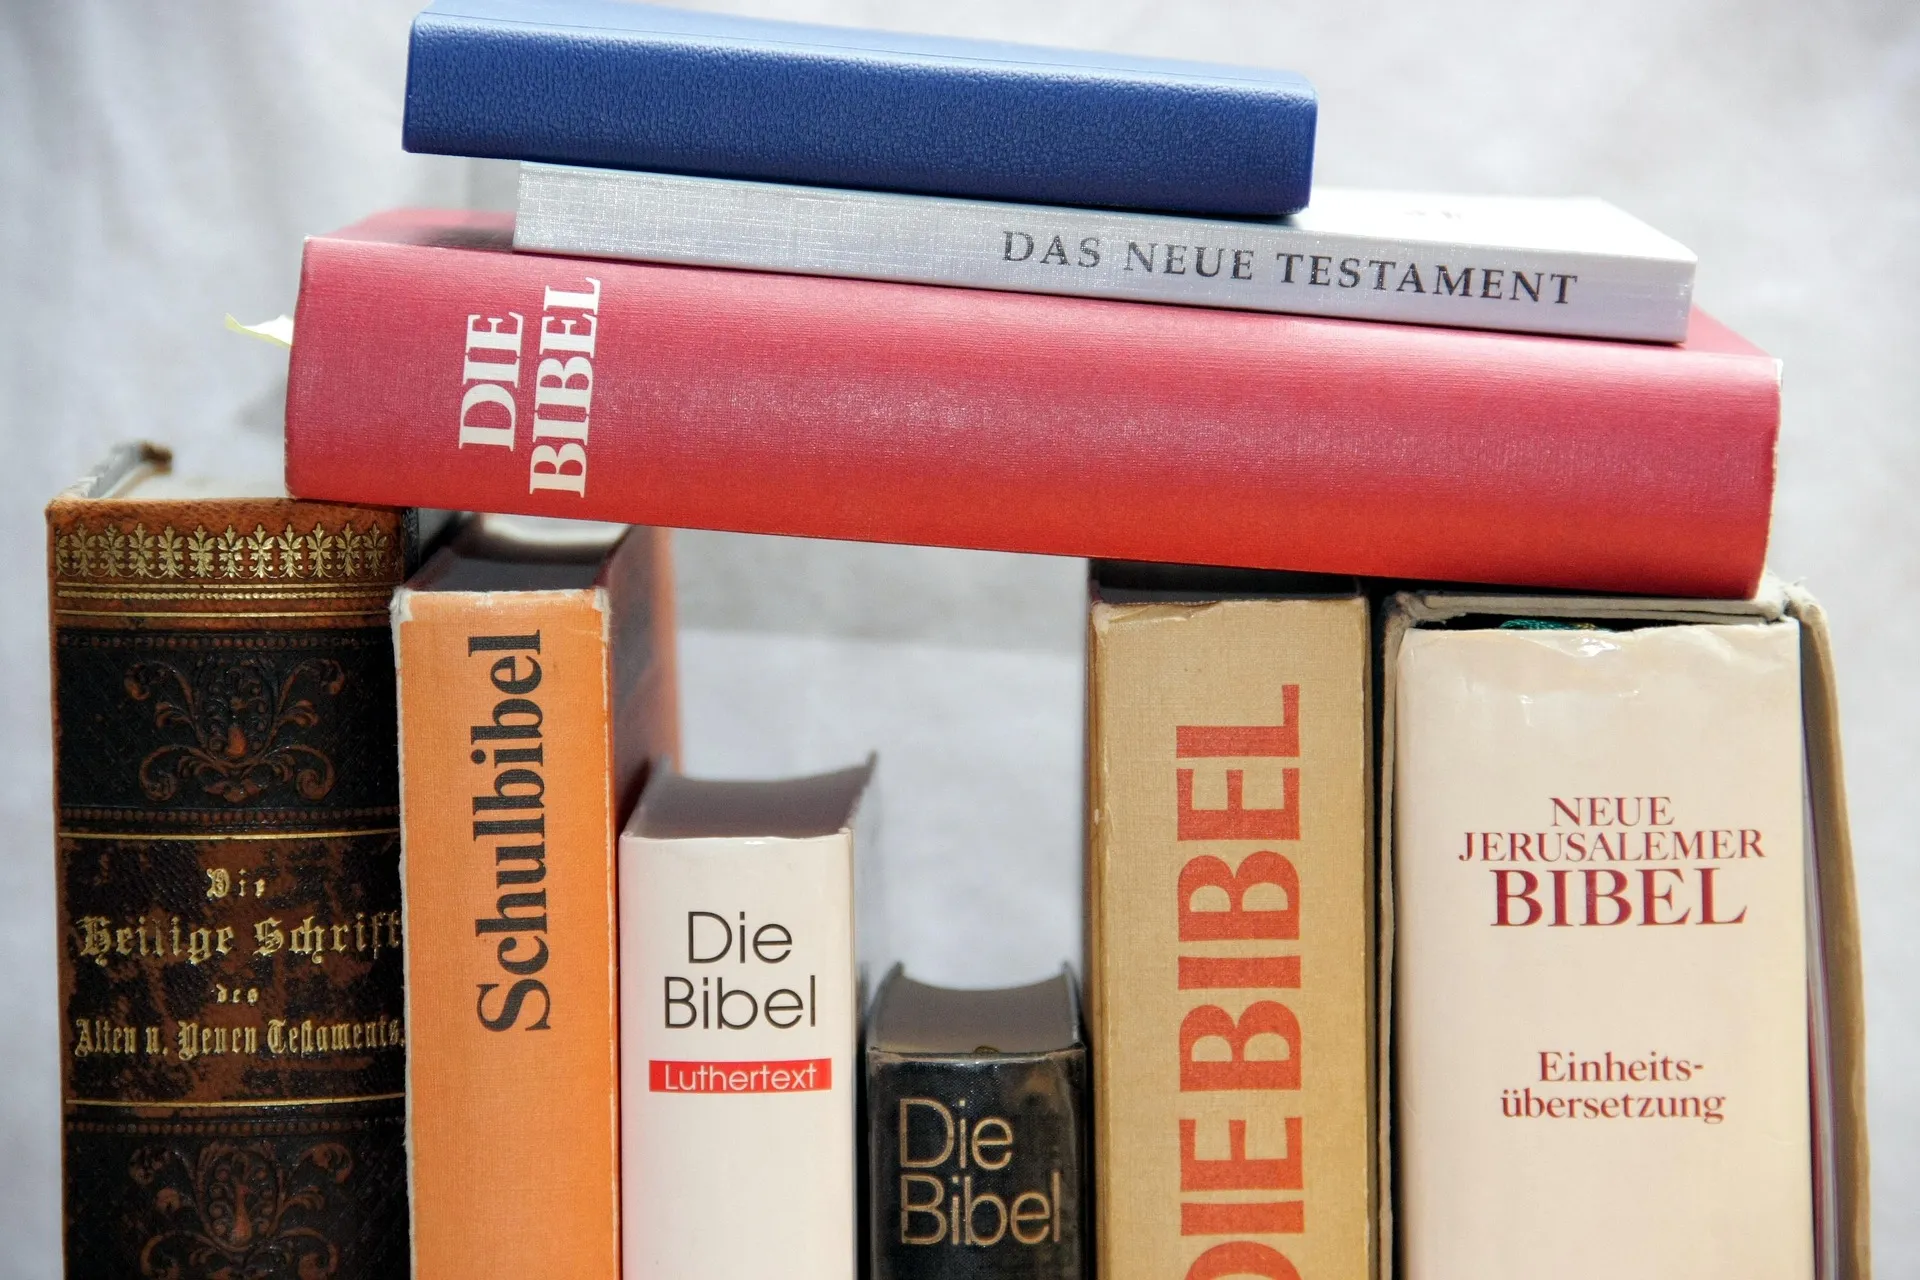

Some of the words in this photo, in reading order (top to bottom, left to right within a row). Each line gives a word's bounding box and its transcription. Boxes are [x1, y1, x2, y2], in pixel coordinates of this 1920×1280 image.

[1003, 229, 1102, 270] DAS
[1122, 240, 1255, 282] NEUE
[1277, 252, 1579, 305] TESTAMENT
[458, 311, 524, 452] DIE
[529, 276, 601, 498] BIBEL
[467, 629, 551, 1032] Schulbibel
[1549, 796, 1676, 828] NEUE
[1458, 829, 1767, 863] JERUSALEMER
[205, 867, 267, 901] Die
[1176, 684, 1302, 1092] BIBEL
[1489, 867, 1748, 927] BIBEL
[76, 915, 235, 967] Heilige
[687, 911, 793, 964] Die
[215, 983, 260, 1006] des
[664, 974, 817, 1030] Bibel
[74, 1018, 137, 1058] Alten
[145, 1026, 169, 1057] u.
[664, 1062, 818, 1092] Luthertext
[1538, 1051, 1705, 1083] Einheits-
[1501, 1088, 1727, 1125] übersetzung
[899, 1097, 1013, 1171] Die
[900, 1170, 1061, 1246] Bibel
